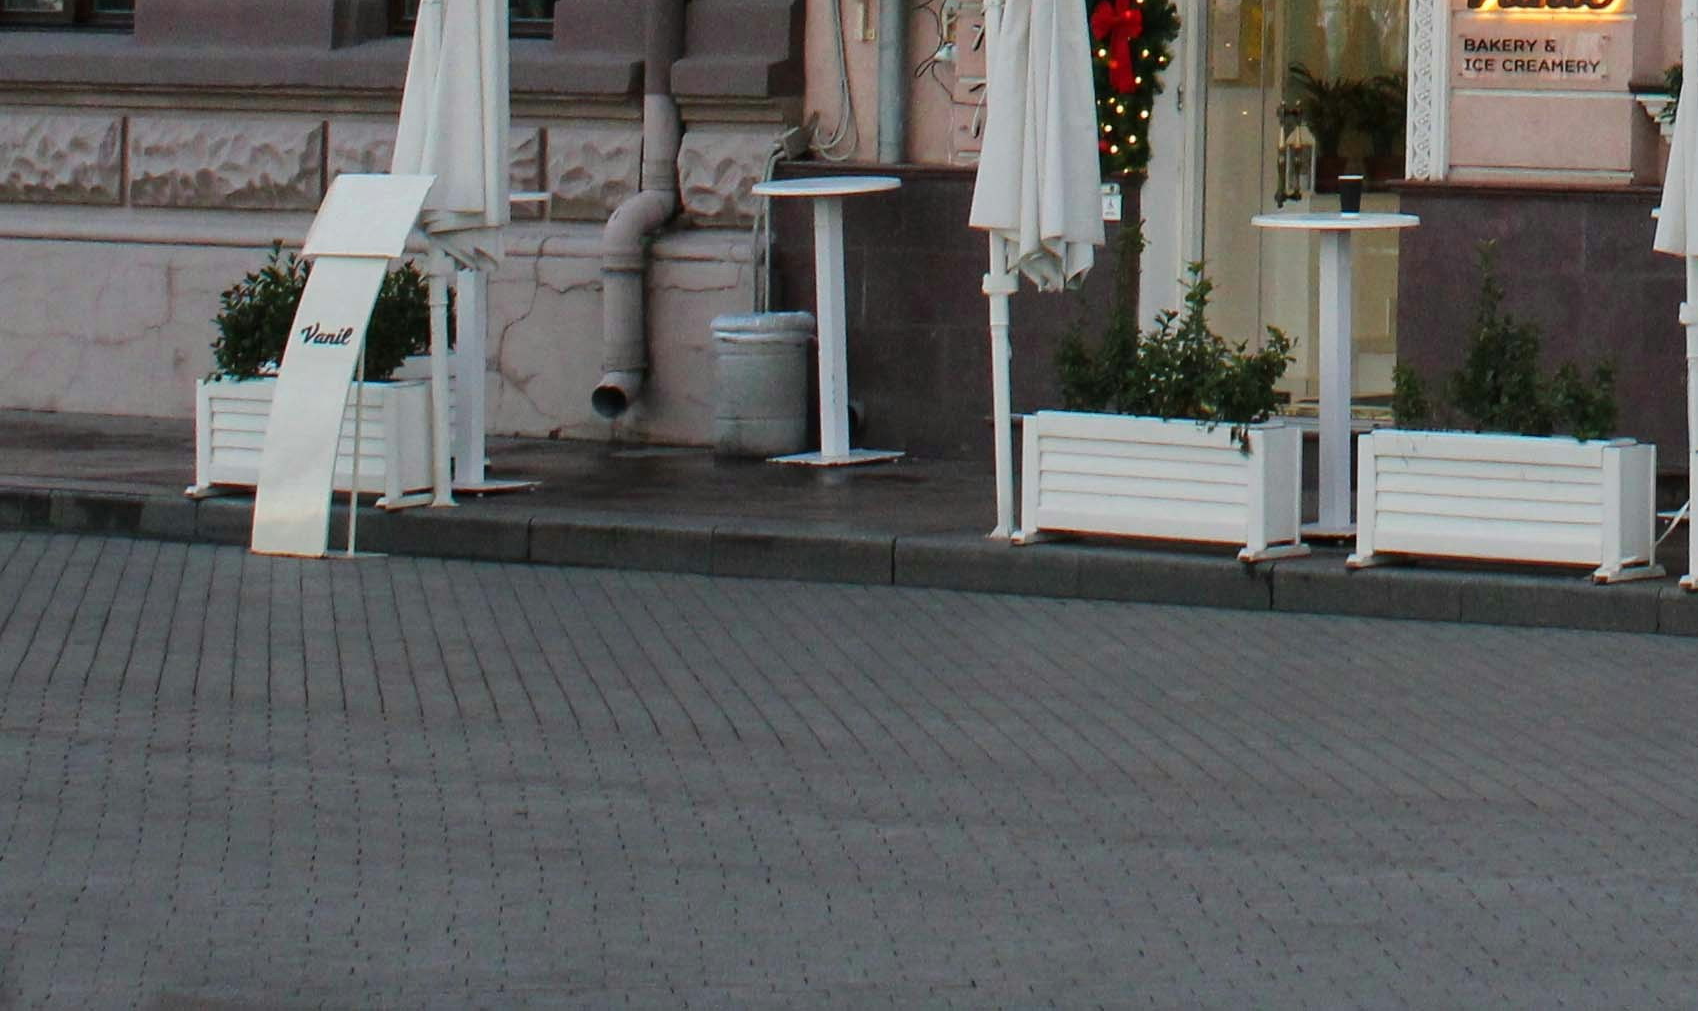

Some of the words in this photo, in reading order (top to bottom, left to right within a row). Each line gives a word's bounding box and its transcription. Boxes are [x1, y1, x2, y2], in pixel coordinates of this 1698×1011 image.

[1464, 39, 1537, 52] BAKERY
[1545, 39, 1556, 52] &
[1465, 58, 1497, 72] ICE
[1502, 59, 1600, 72] CREAMERY
[301, 321, 353, 345] Vanil
